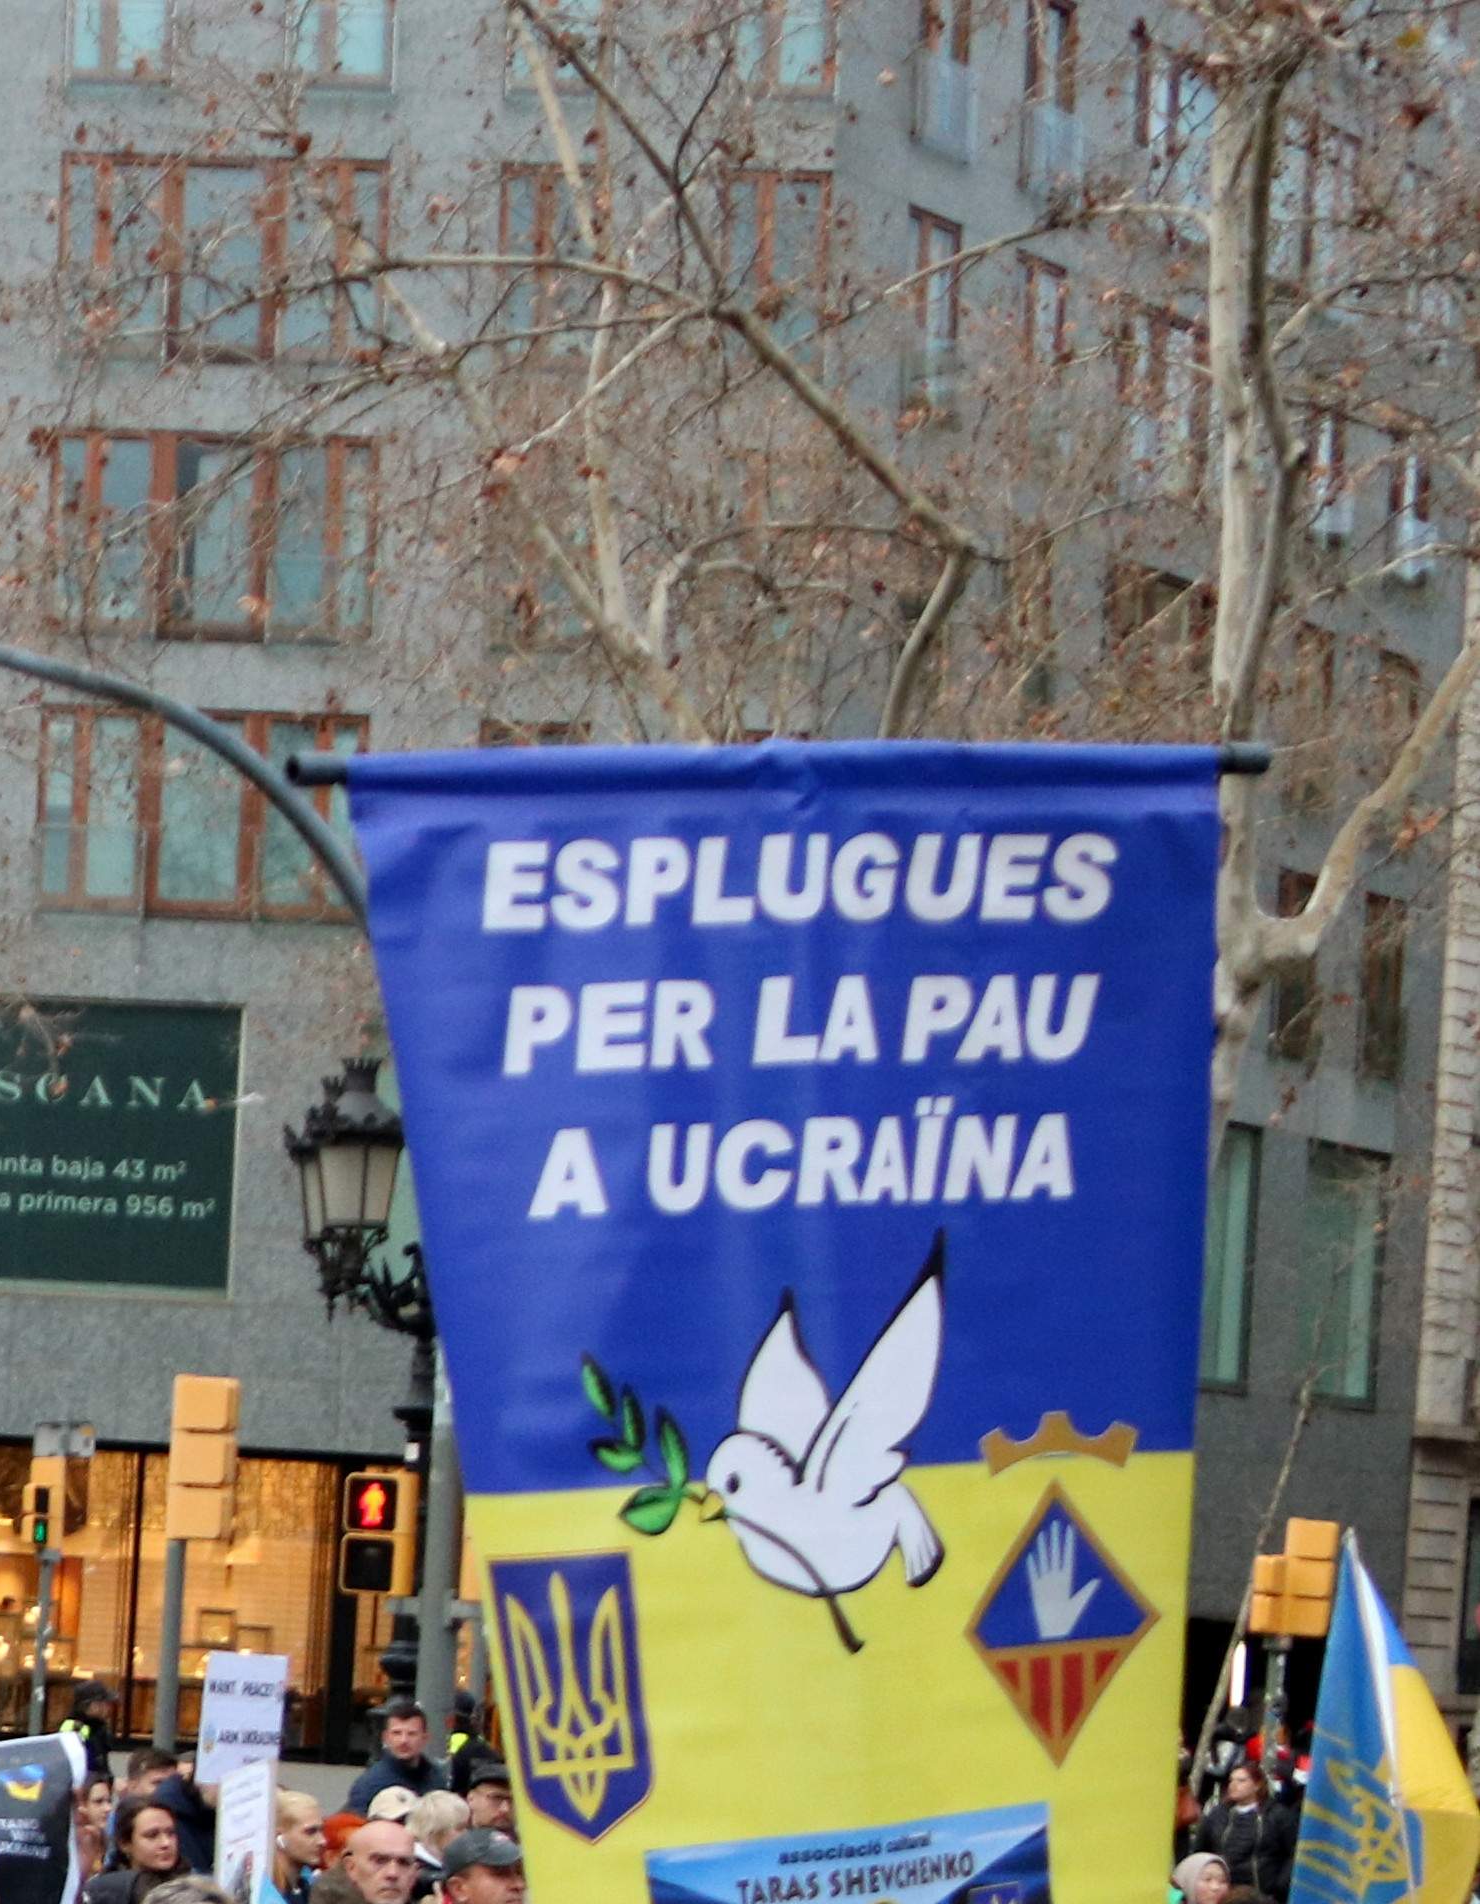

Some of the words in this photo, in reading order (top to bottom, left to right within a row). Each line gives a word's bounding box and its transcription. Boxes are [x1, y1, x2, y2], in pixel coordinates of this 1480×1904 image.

[482, 833, 1118, 931] ESPLUGUES
[502, 979, 715, 1076] PER
[753, 975, 878, 1068] LA
[901, 974, 1101, 1064] PAU
[51, 1154, 105, 1181] baja
[113, 1159, 145, 1179] 43
[527, 1127, 608, 1220] A
[648, 1096, 1074, 1214] UCRAÏNA
[18, 1188, 117, 1214] primera
[126, 1194, 174, 1217] 956
[829, 1849, 976, 1898] SHEVCHENKO
